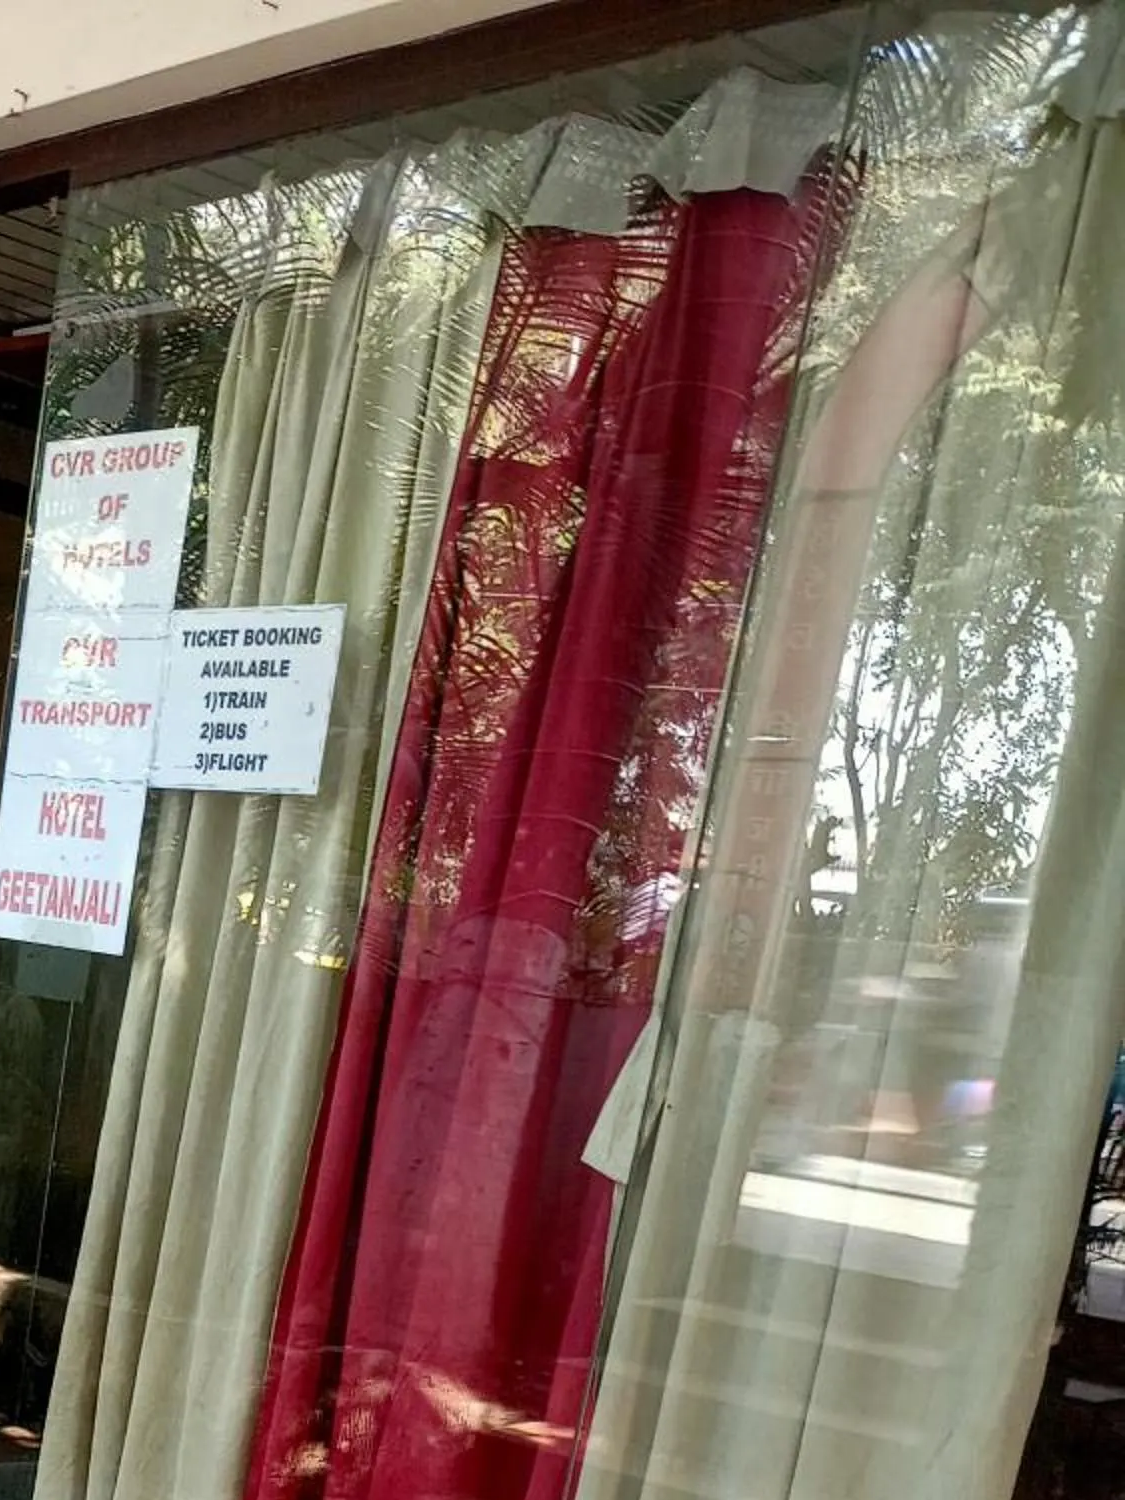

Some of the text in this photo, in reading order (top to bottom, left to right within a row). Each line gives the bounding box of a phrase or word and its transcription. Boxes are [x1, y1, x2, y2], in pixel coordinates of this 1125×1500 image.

[50, 441, 187, 479] CVR GROUP
[98, 493, 130, 521] OF
[182, 626, 322, 648] TICKET BOOKING
[200, 659, 291, 679] AVAILABLE
[20, 700, 152, 728] TRANSPORT
[203, 691, 268, 714] 1)TRAIN
[199, 721, 248, 744] 2)BUS
[194, 752, 268, 775] 3)FLIGHT
[38, 791, 107, 841] HOTEL
